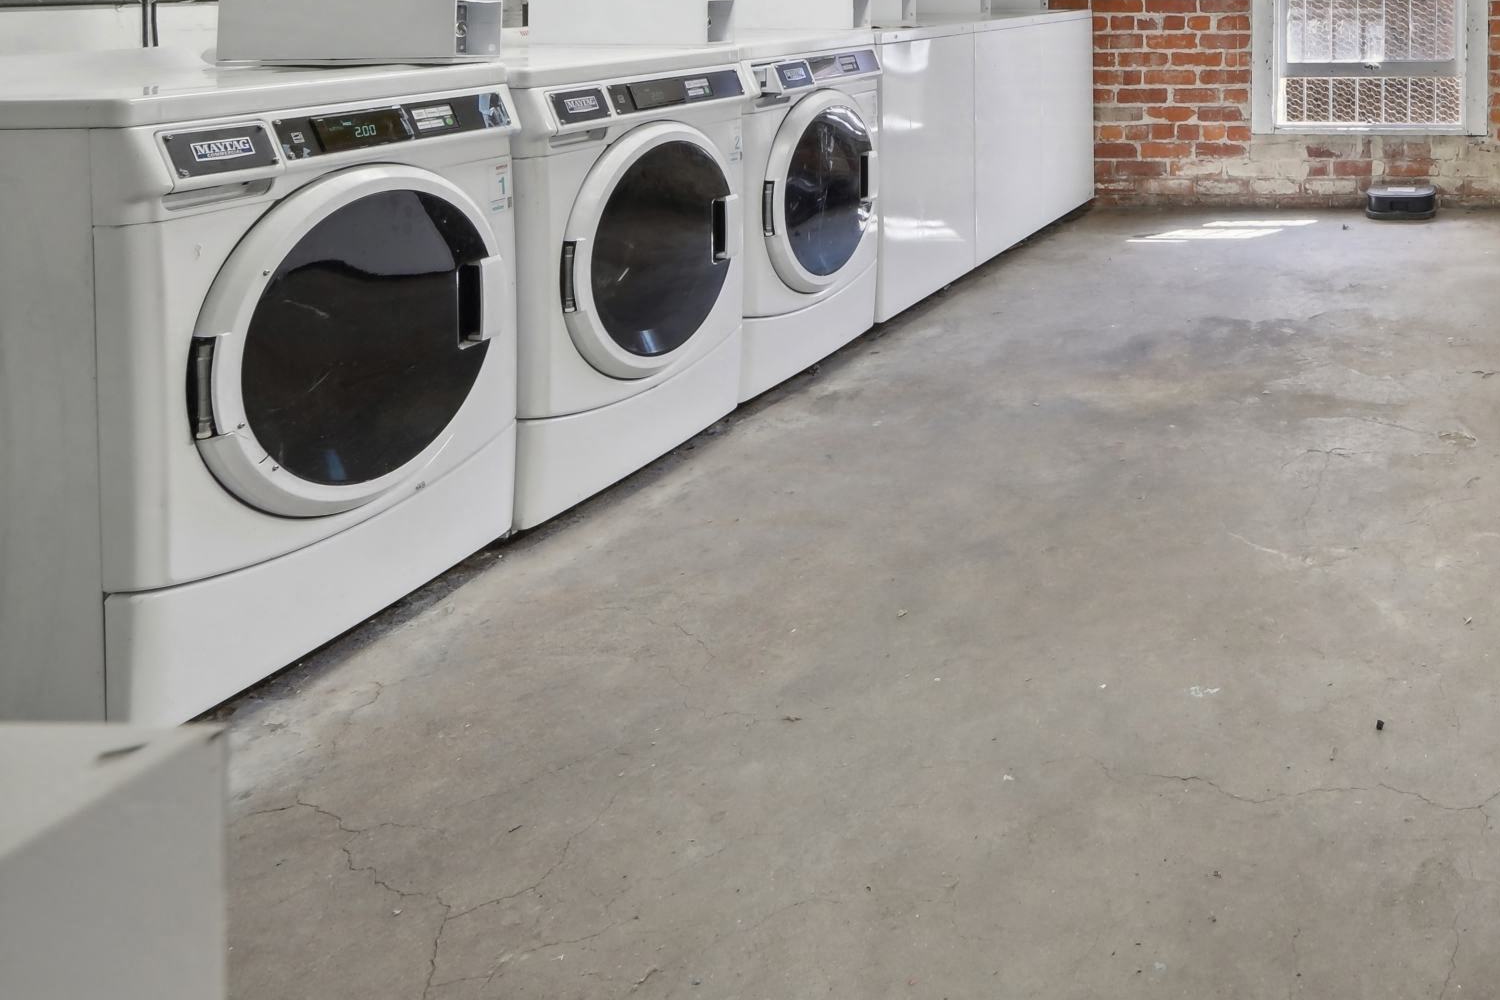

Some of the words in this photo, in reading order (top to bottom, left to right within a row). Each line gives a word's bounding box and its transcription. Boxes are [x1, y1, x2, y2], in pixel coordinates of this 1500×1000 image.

[566, 97, 597, 109] MAYTAG
[354, 124, 377, 138] 2.00
[194, 139, 250, 155] MAYTAG
[498, 176, 506, 195] 1
